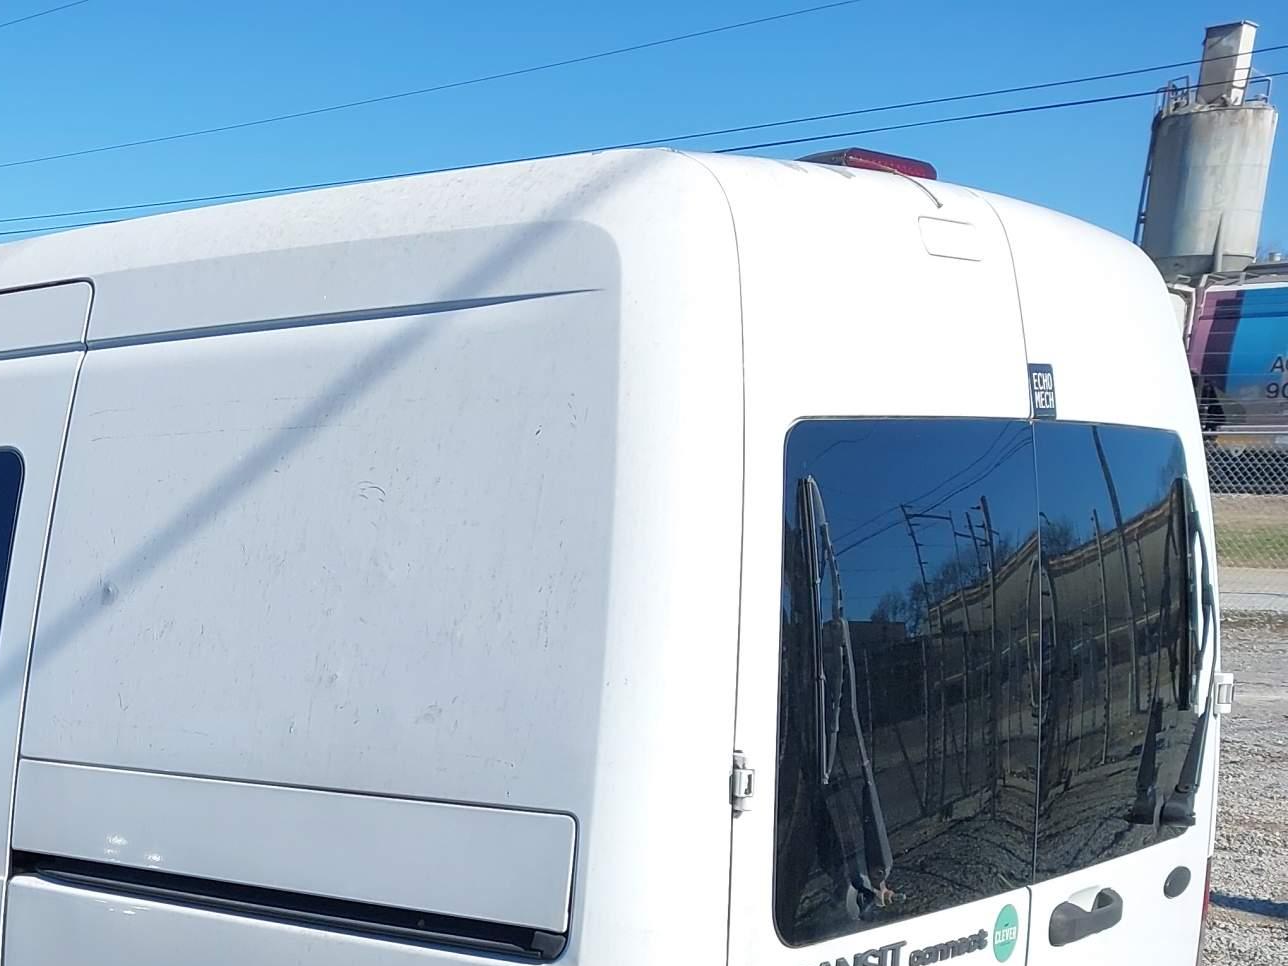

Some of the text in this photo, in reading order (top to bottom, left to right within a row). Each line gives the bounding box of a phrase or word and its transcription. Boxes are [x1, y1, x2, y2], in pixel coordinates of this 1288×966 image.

[1270, 355, 1288, 373] A
[1032, 372, 1053, 390] ECHO
[1034, 391, 1055, 409] MECH
